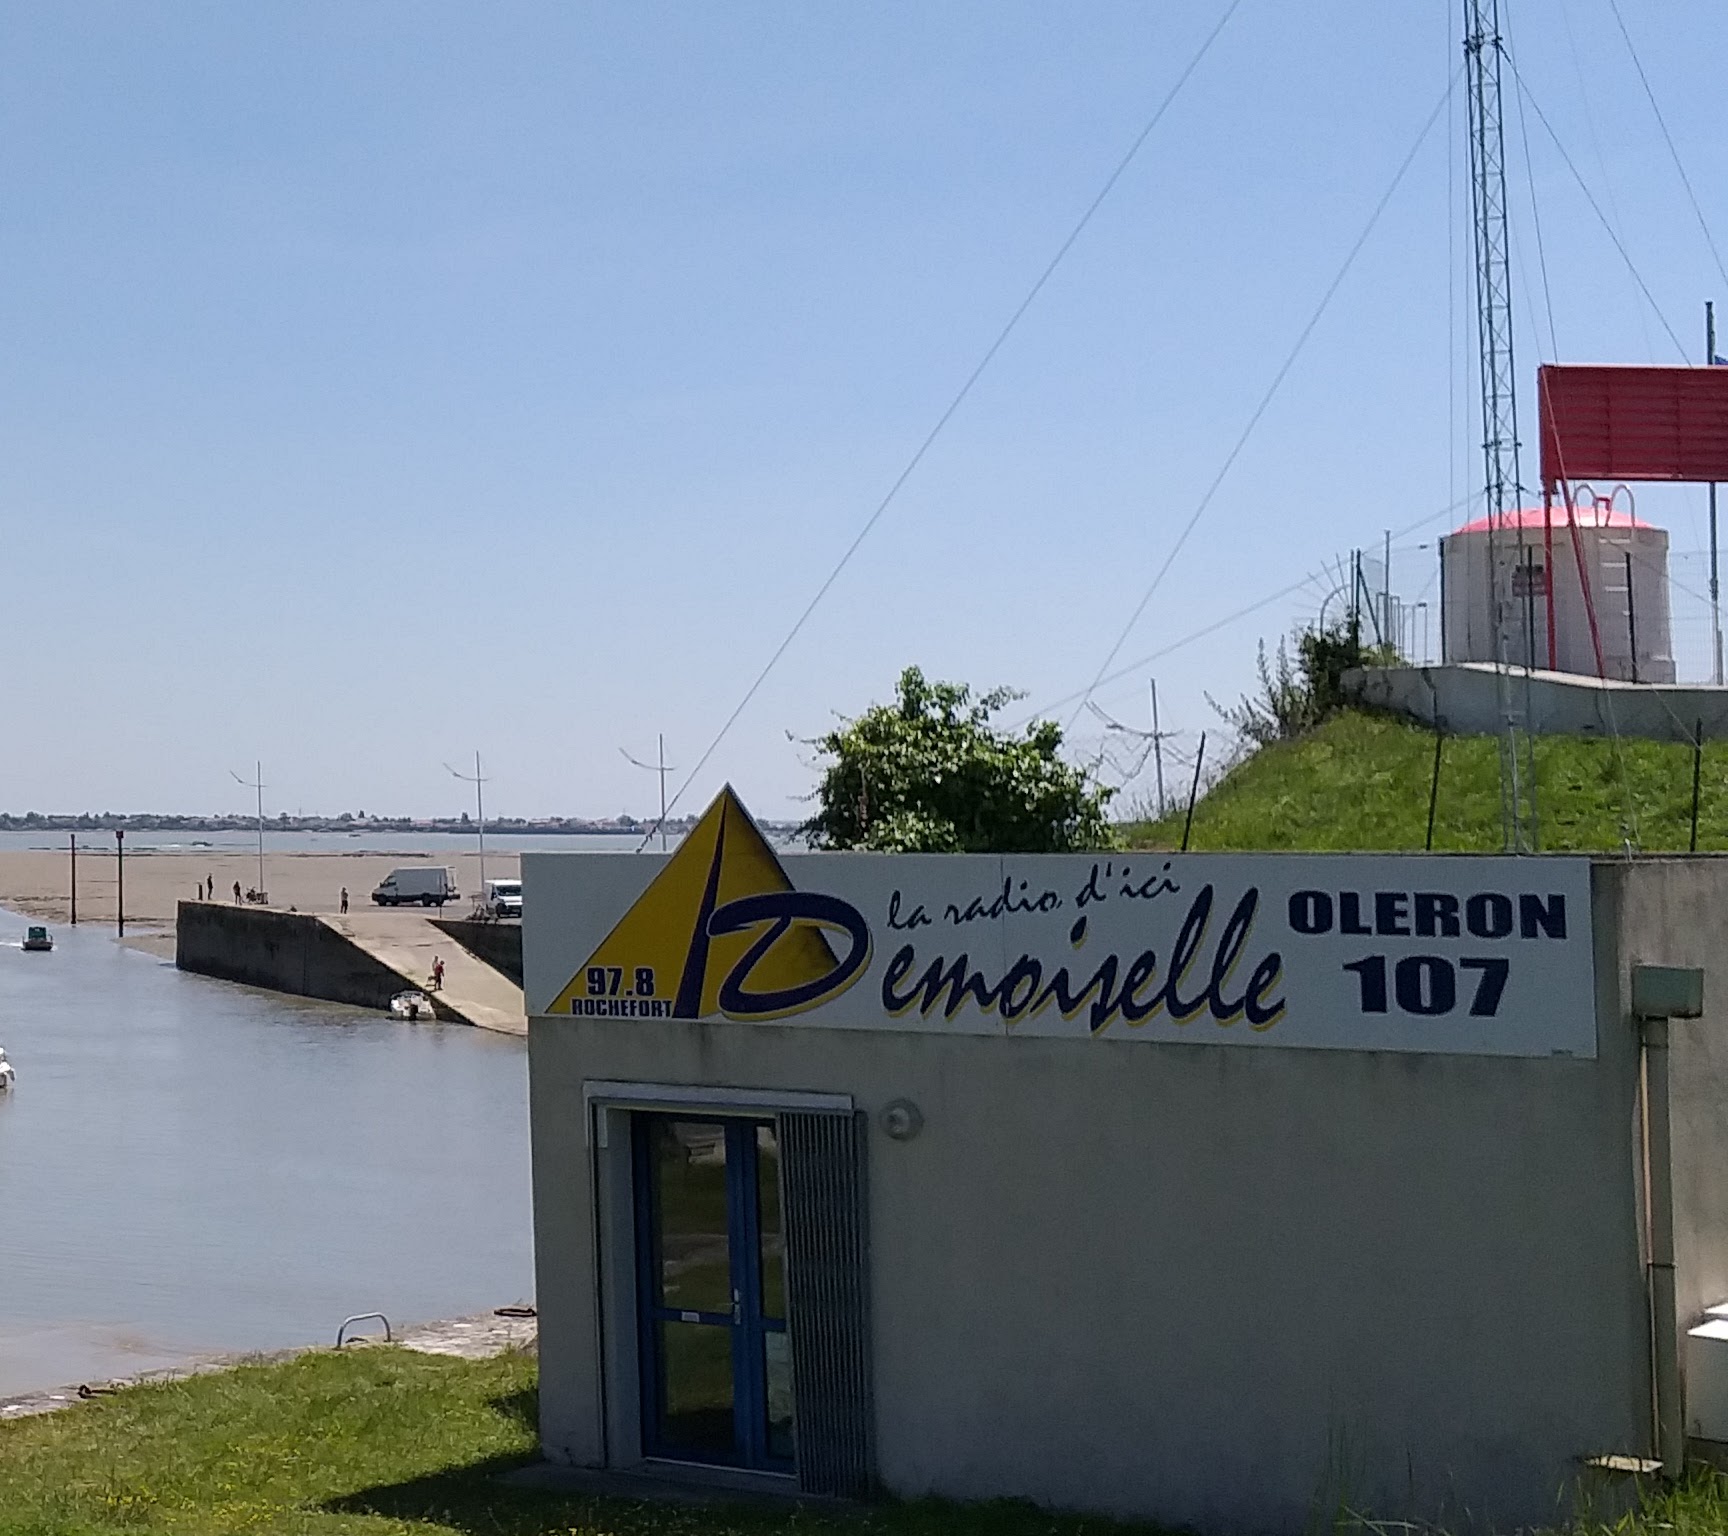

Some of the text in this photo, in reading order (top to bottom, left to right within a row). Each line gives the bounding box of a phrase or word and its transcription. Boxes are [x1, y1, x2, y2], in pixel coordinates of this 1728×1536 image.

[887, 861, 1180, 930] la radio d'ici
[1288, 889, 1568, 940] OLERON
[586, 966, 655, 997] 97.8
[1342, 954, 1510, 1019] 107
[571, 998, 673, 1018] ROCHEFORT
